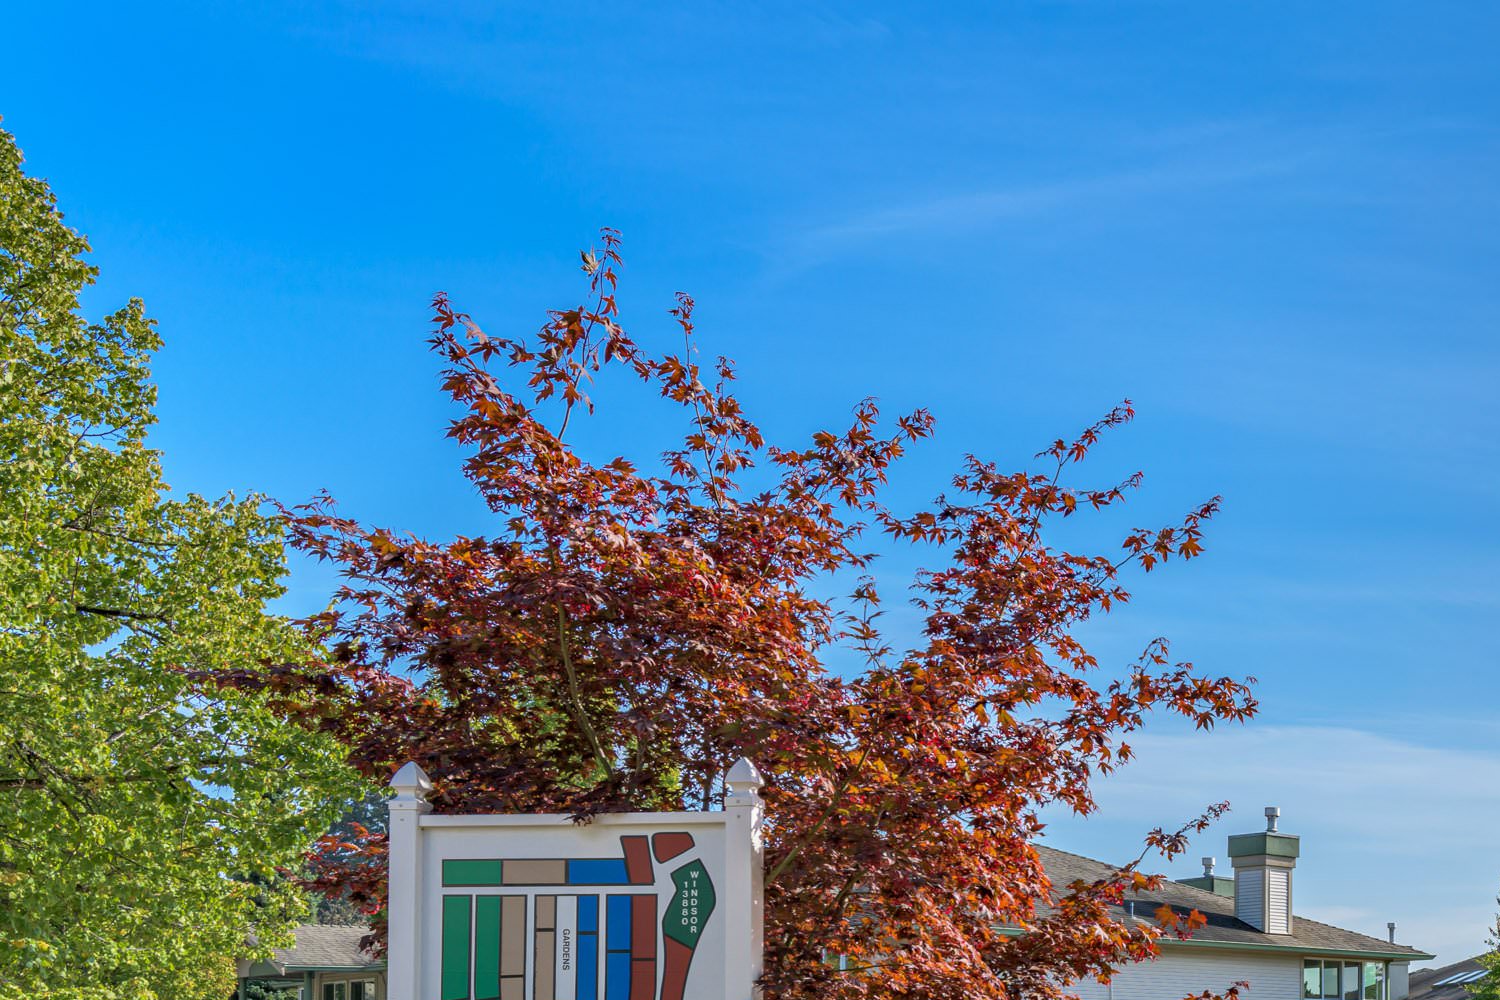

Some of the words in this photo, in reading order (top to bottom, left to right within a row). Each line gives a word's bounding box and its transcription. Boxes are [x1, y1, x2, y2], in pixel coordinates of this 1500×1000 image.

[681, 881, 689, 925] 13880
[690, 871, 699, 934] WINDSOR
[562, 928, 571, 971] GARDENS
